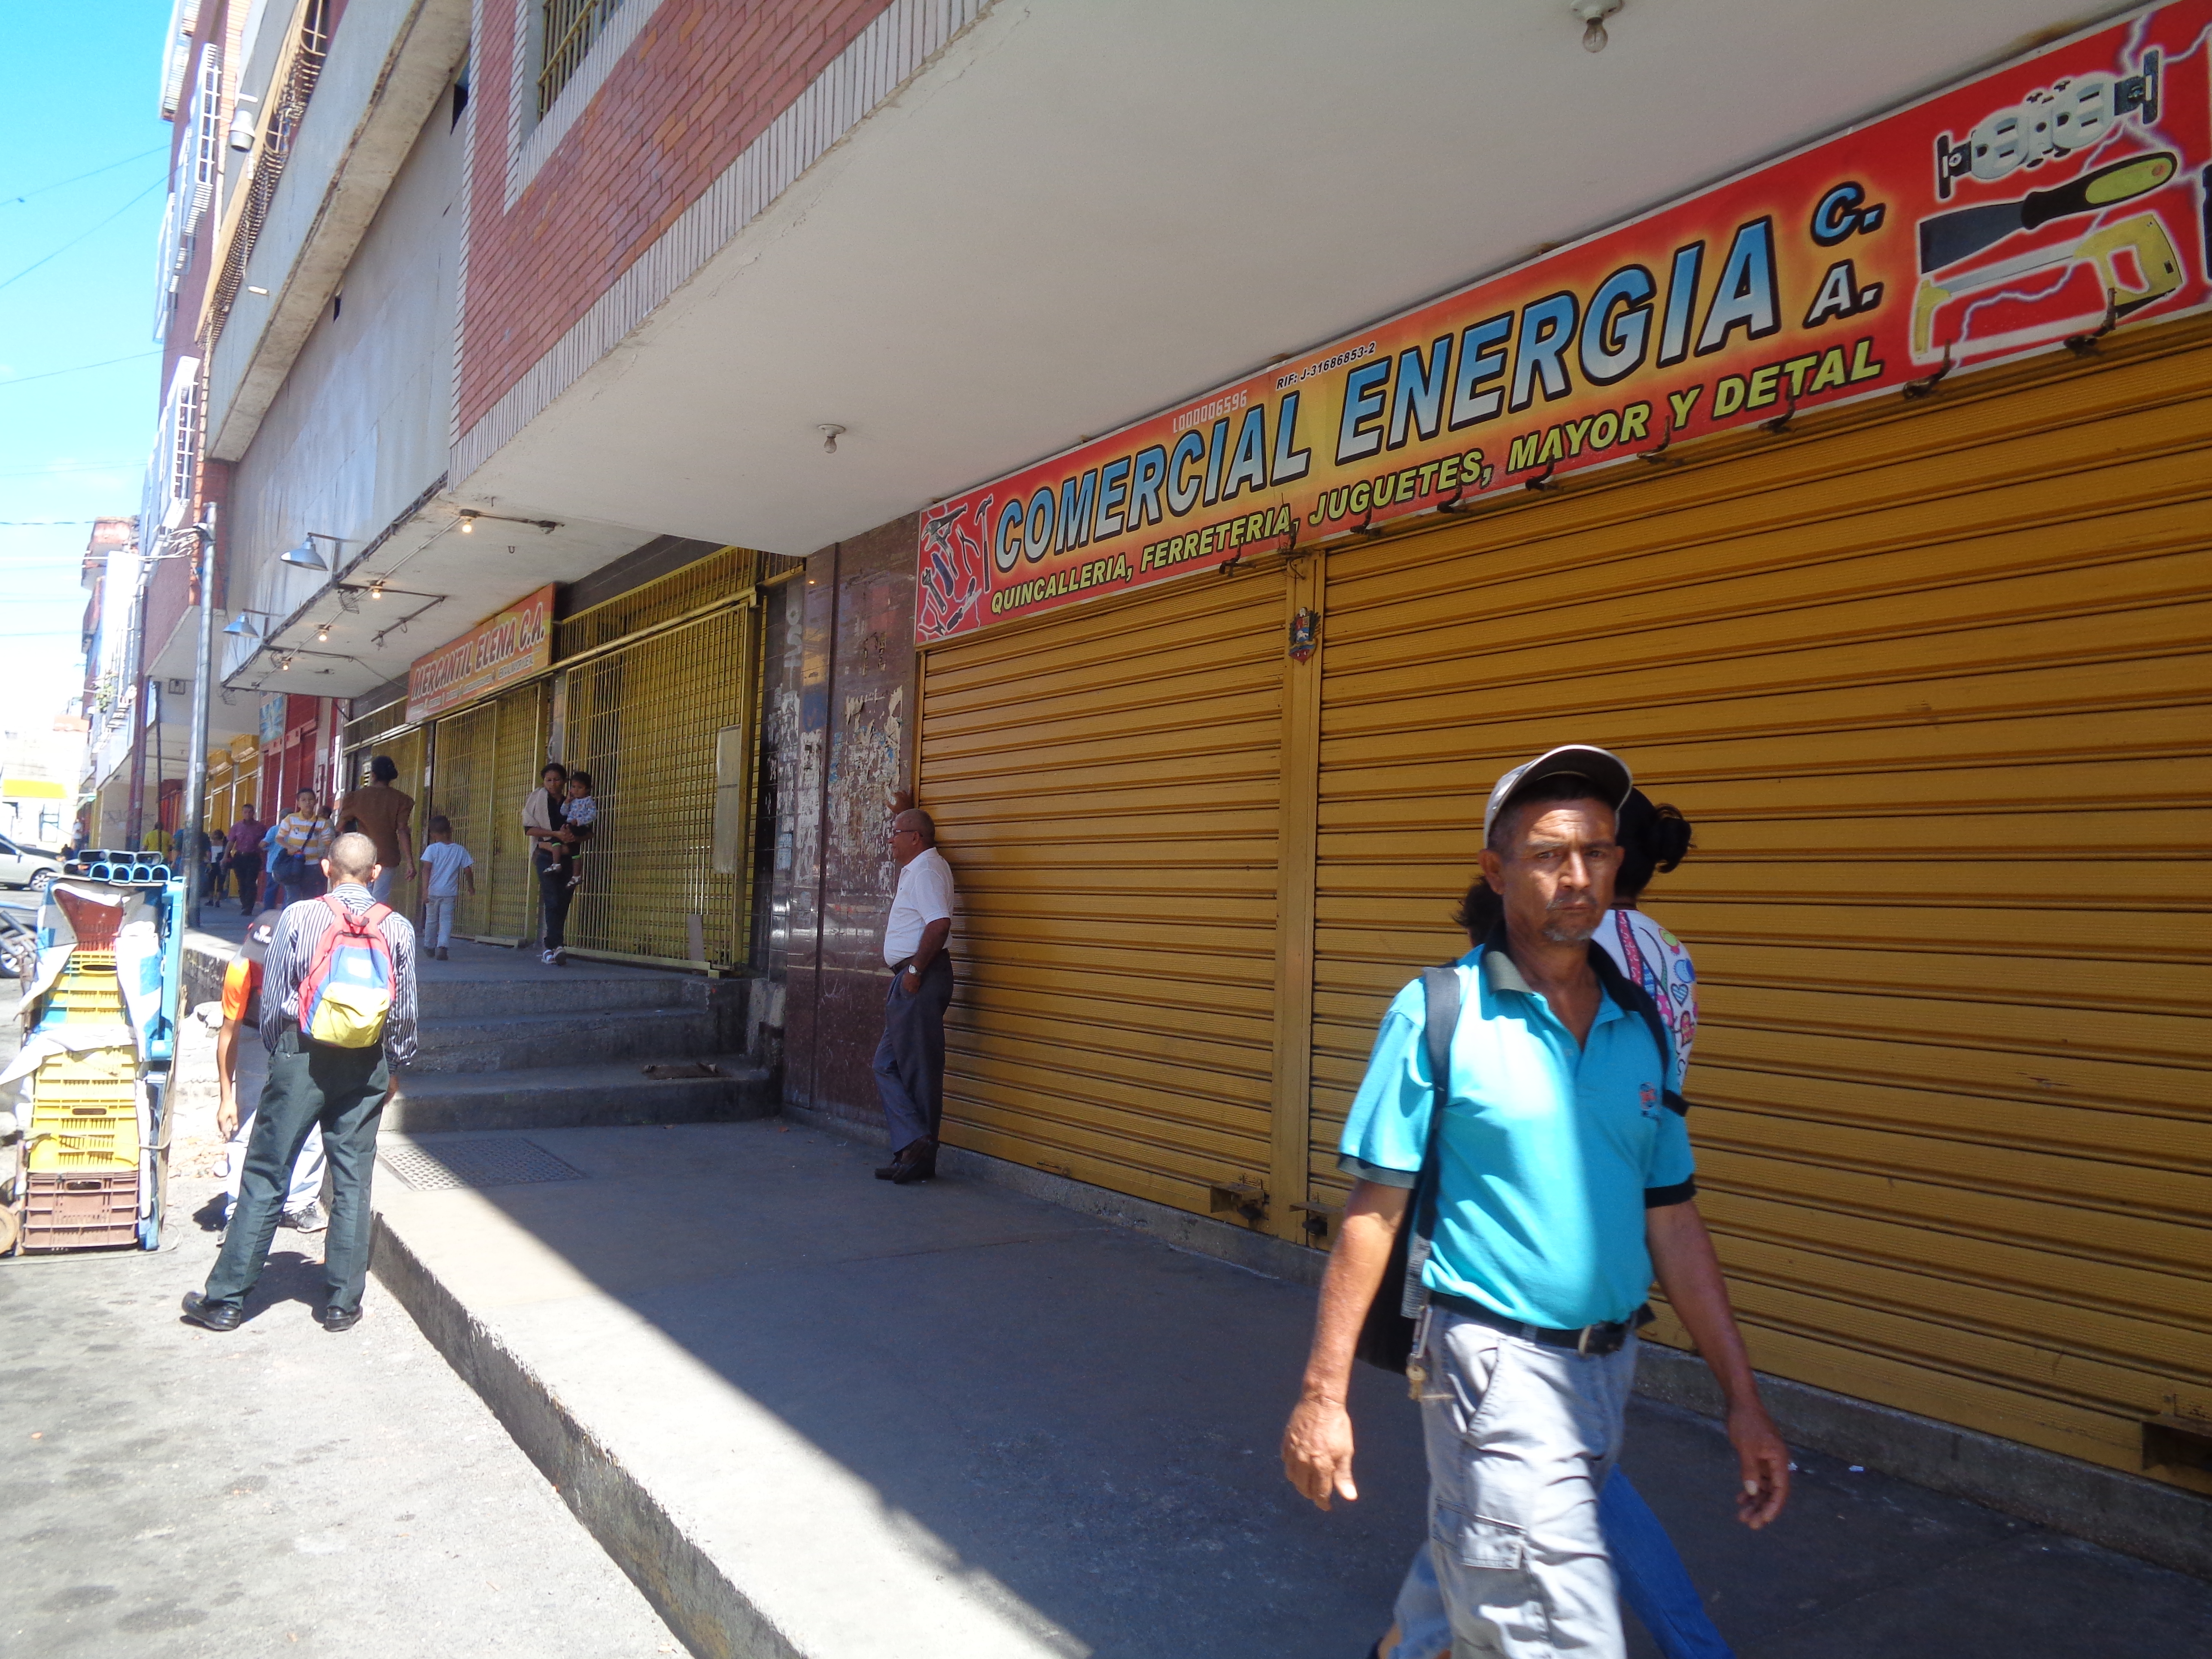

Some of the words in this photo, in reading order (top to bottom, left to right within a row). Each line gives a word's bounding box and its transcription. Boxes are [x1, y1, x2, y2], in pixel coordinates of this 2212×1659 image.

[1811, 182, 1884, 246] C.
[1803, 260, 1883, 328] A.
[996, 391, 1311, 571] COMERCIAL
[1335, 216, 1780, 465] ENERGIA
[1276, 374, 1298, 391] RIF:
[1300, 342, 1376, 381] J-31686853-2
[991, 555, 1132, 614] QUINCALLERIA,
[1141, 505, 1299, 572] FERRETERIA,
[1310, 450, 1492, 525] JUGUETES,
[1509, 400, 1652, 472] MAYOR
[1669, 385, 1704, 429] Y
[1712, 338, 1883, 419] DETAL
[411, 641, 474, 701] MERCANTIL
[475, 617, 516, 672] ELENA
[519, 602, 545, 652] C.A.
